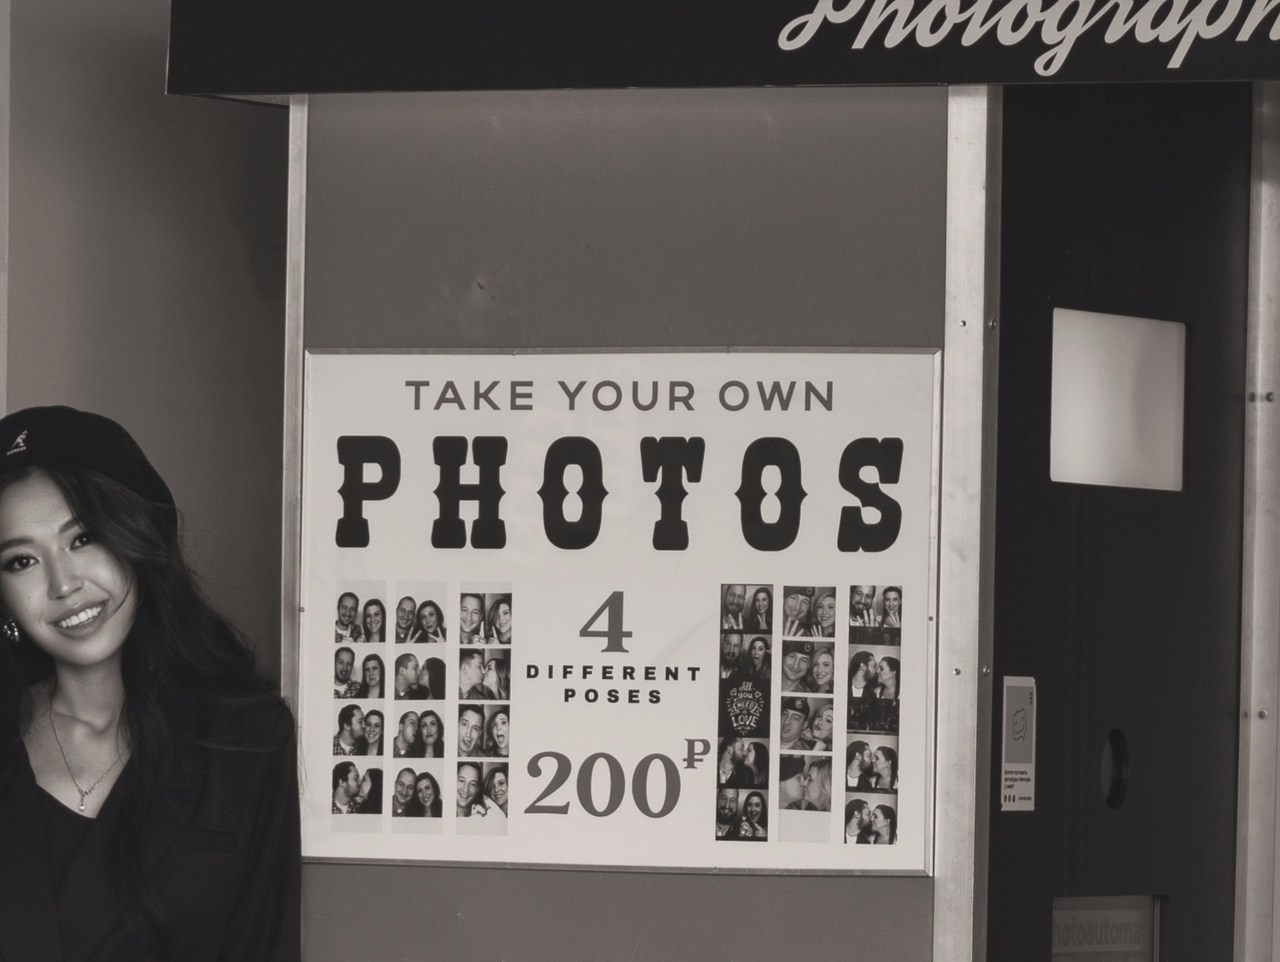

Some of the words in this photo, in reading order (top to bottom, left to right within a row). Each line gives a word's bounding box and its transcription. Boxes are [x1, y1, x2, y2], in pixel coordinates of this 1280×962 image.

[405, 381, 534, 411] TAKE
[558, 381, 695, 412] YOUR
[718, 380, 834, 412] OWN
[335, 435, 904, 553] PHOTOS
[579, 590, 633, 654] 4
[526, 664, 701, 682] DIFFERENT
[564, 688, 662, 705] POSES
[731, 714, 758, 727] LOVE
